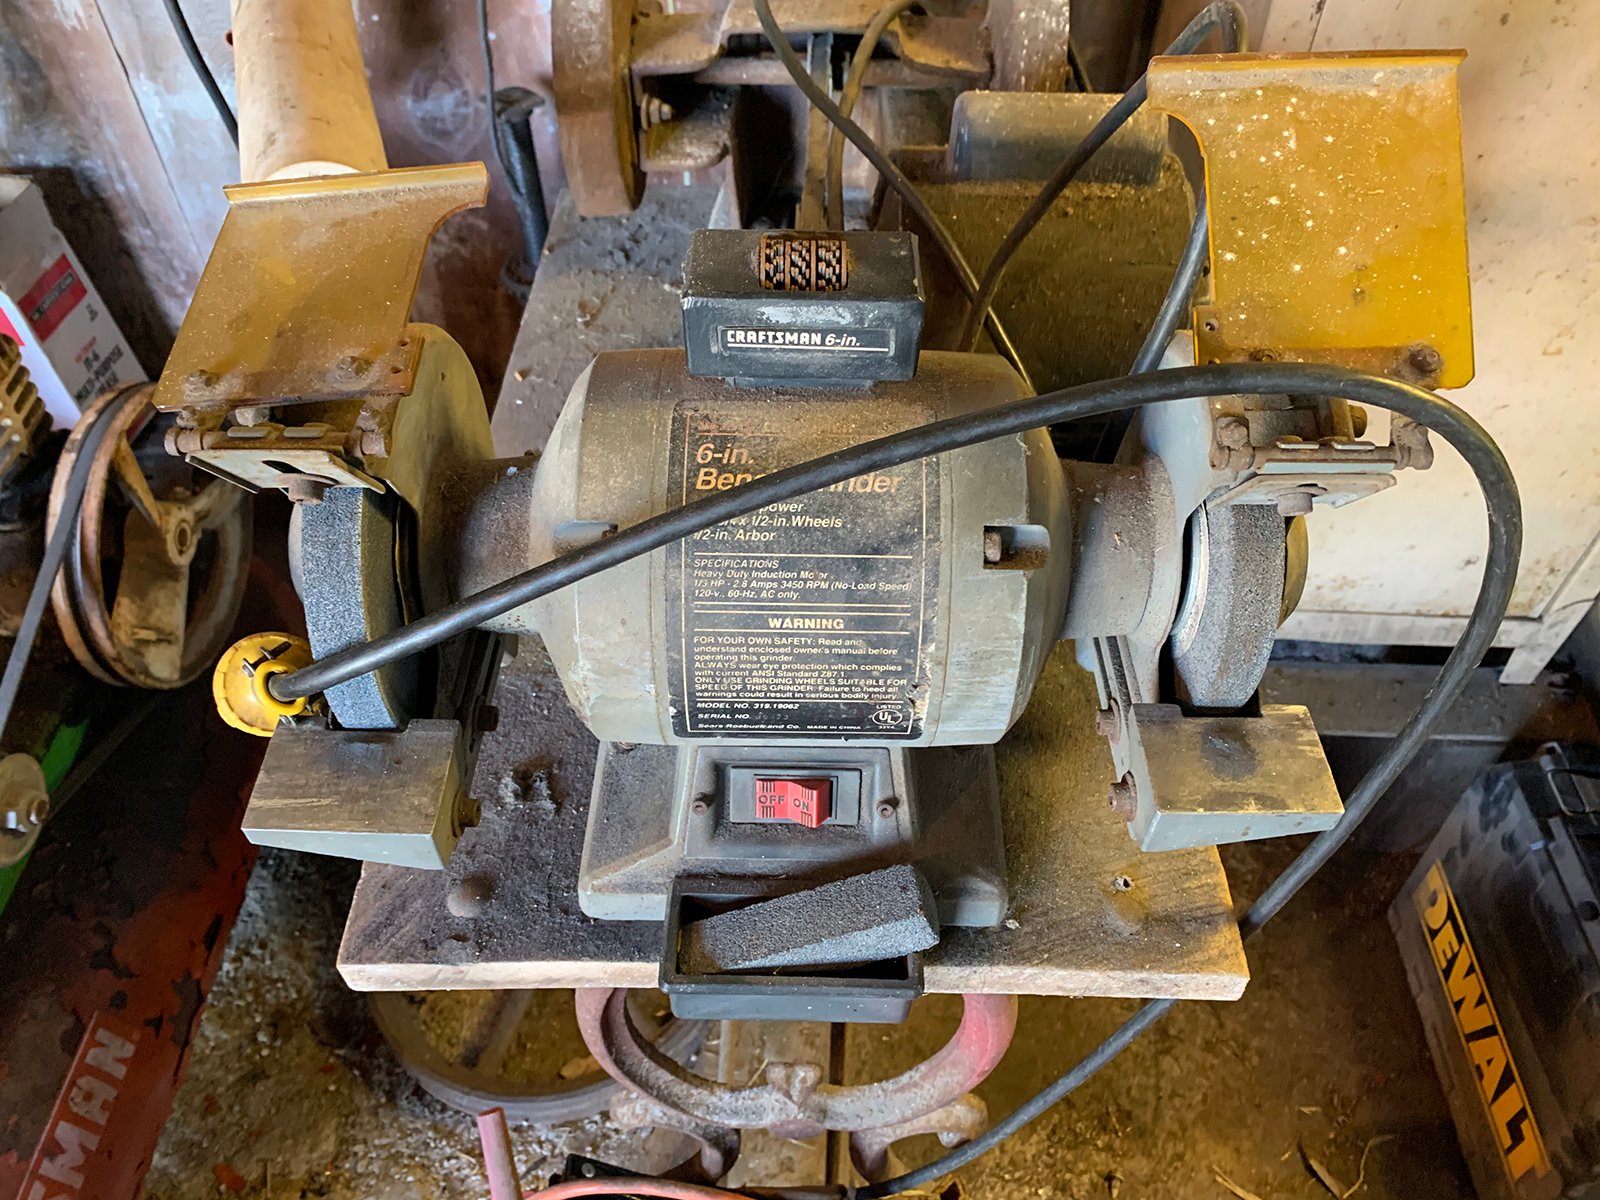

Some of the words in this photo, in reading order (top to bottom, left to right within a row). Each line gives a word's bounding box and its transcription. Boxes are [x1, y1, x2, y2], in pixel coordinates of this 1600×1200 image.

[726, 330, 822, 346] CRAFTSMAN
[825, 334, 860, 346] 6-in.
[696, 442, 754, 464] 6-in.
[696, 467, 778, 490] Ben
[752, 514, 790, 526] 1/2-in.
[790, 514, 844, 528] Wheels
[734, 528, 777, 542] Arbor
[694, 559, 780, 568] SPECIFICATIONS
[694, 570, 726, 580] Heavy
[727, 570, 750, 580] Duty
[752, 570, 797, 579] Induction
[800, 570, 828, 580] Moor
[694, 580, 708, 588] 1/3
[710, 580, 725, 588] HP
[750, 580, 778, 590] Amps
[781, 581, 804, 589] 3450
[806, 581, 830, 589] RPM
[831, 582, 876, 590] (No-Load
[879, 582, 912, 591] Speed)
[760, 590, 775, 598] AC
[768, 618, 844, 629] WARNING
[694, 636, 714, 644] FOR
[717, 636, 745, 644] YOUR
[748, 637, 772, 645] OWN
[774, 637, 816, 645] SAFETY:
[818, 638, 842, 646] Read
[832, 647, 866, 655] manual
[694, 655, 738, 663] operating
[694, 661, 736, 669] ALWAYS
[781, 663, 828, 671] protection
[860, 664, 902, 672] complies
[695, 676, 721, 684] ONLY
[837, 678, 885, 686] SUITABLE
[758, 795, 785, 804] OFF
[793, 798, 810, 811] ON
[1414, 864, 1550, 1180] DEWALT
[27, 1028, 137, 1200] MAN
